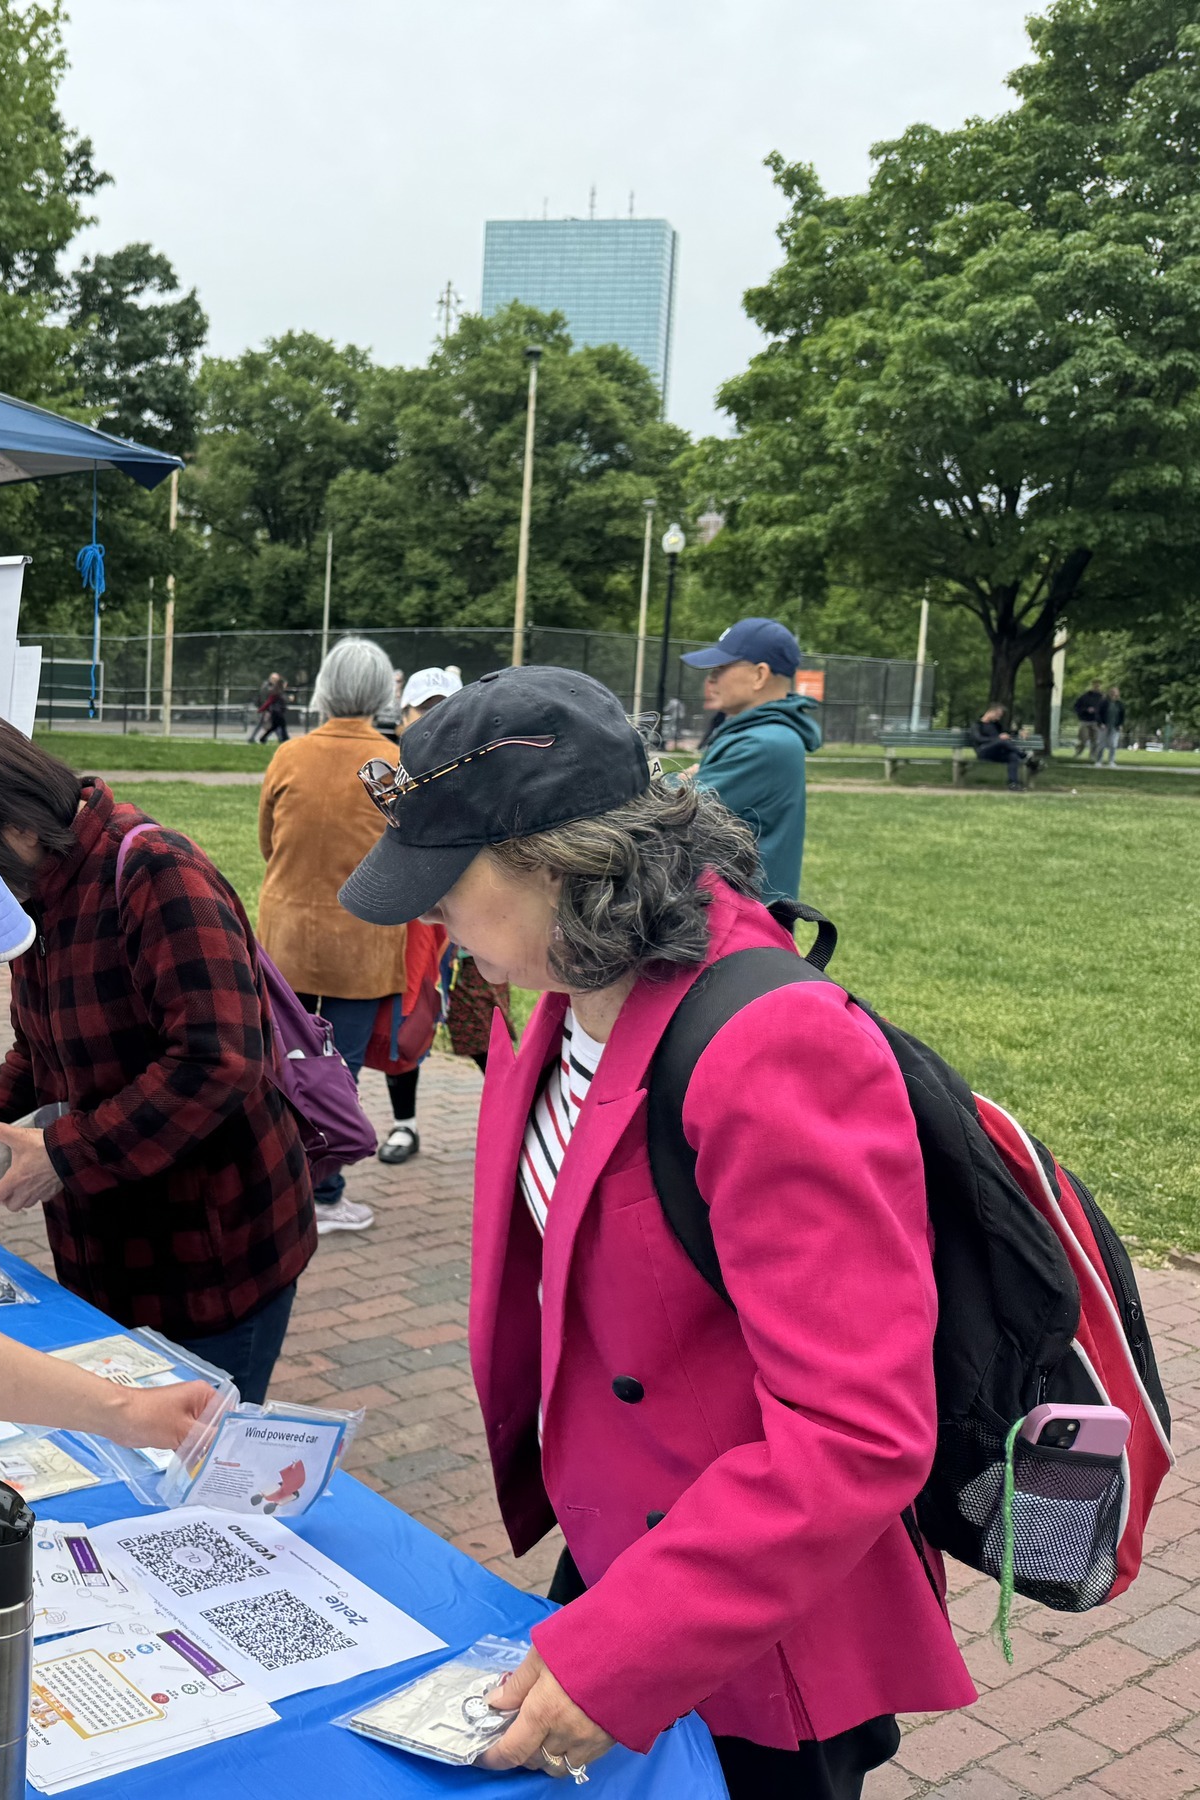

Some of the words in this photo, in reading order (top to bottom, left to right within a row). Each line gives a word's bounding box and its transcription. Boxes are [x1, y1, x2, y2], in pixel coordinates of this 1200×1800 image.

[245, 1427, 268, 1439] Wind
[266, 1430, 306, 1443] powered
[305, 1435, 319, 1444] car
[227, 1524, 277, 1561] venmo
